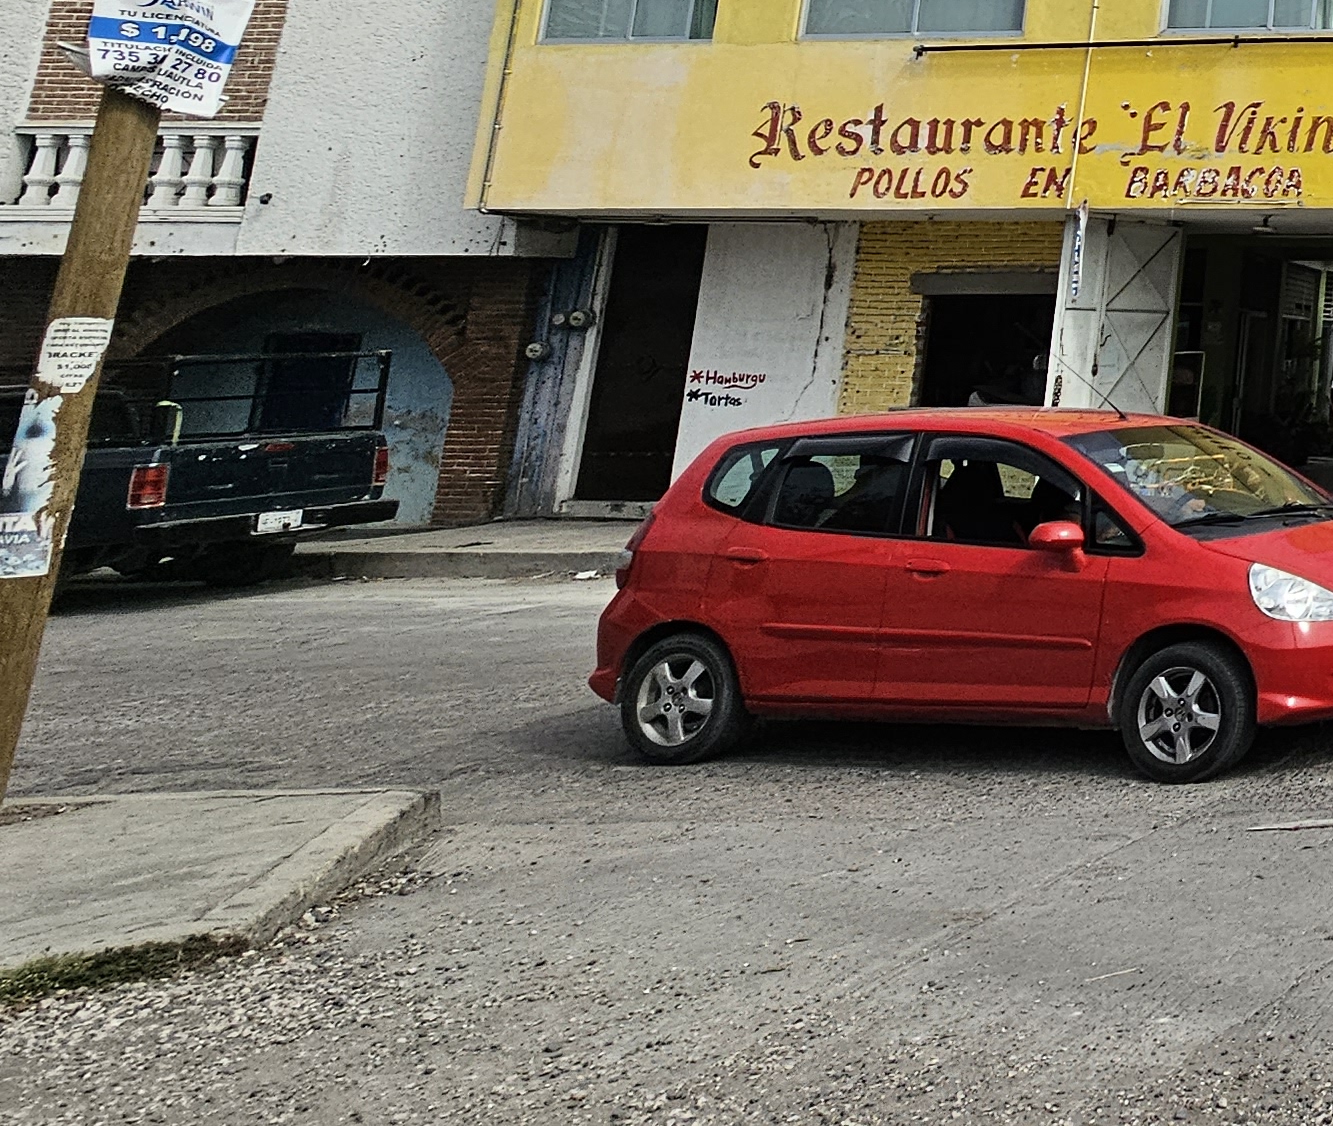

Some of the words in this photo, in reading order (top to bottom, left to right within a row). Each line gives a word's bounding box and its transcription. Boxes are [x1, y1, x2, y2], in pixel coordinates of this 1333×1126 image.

[118, 9, 137, 17] TU
[97, 48, 140, 63] 735
[170, 58, 193, 73] 27
[194, 67, 221, 83] 80
[749, 100, 1098, 169] Restaurante
[849, 167, 973, 199] POLLOS
[1021, 167, 1072, 199] EN
